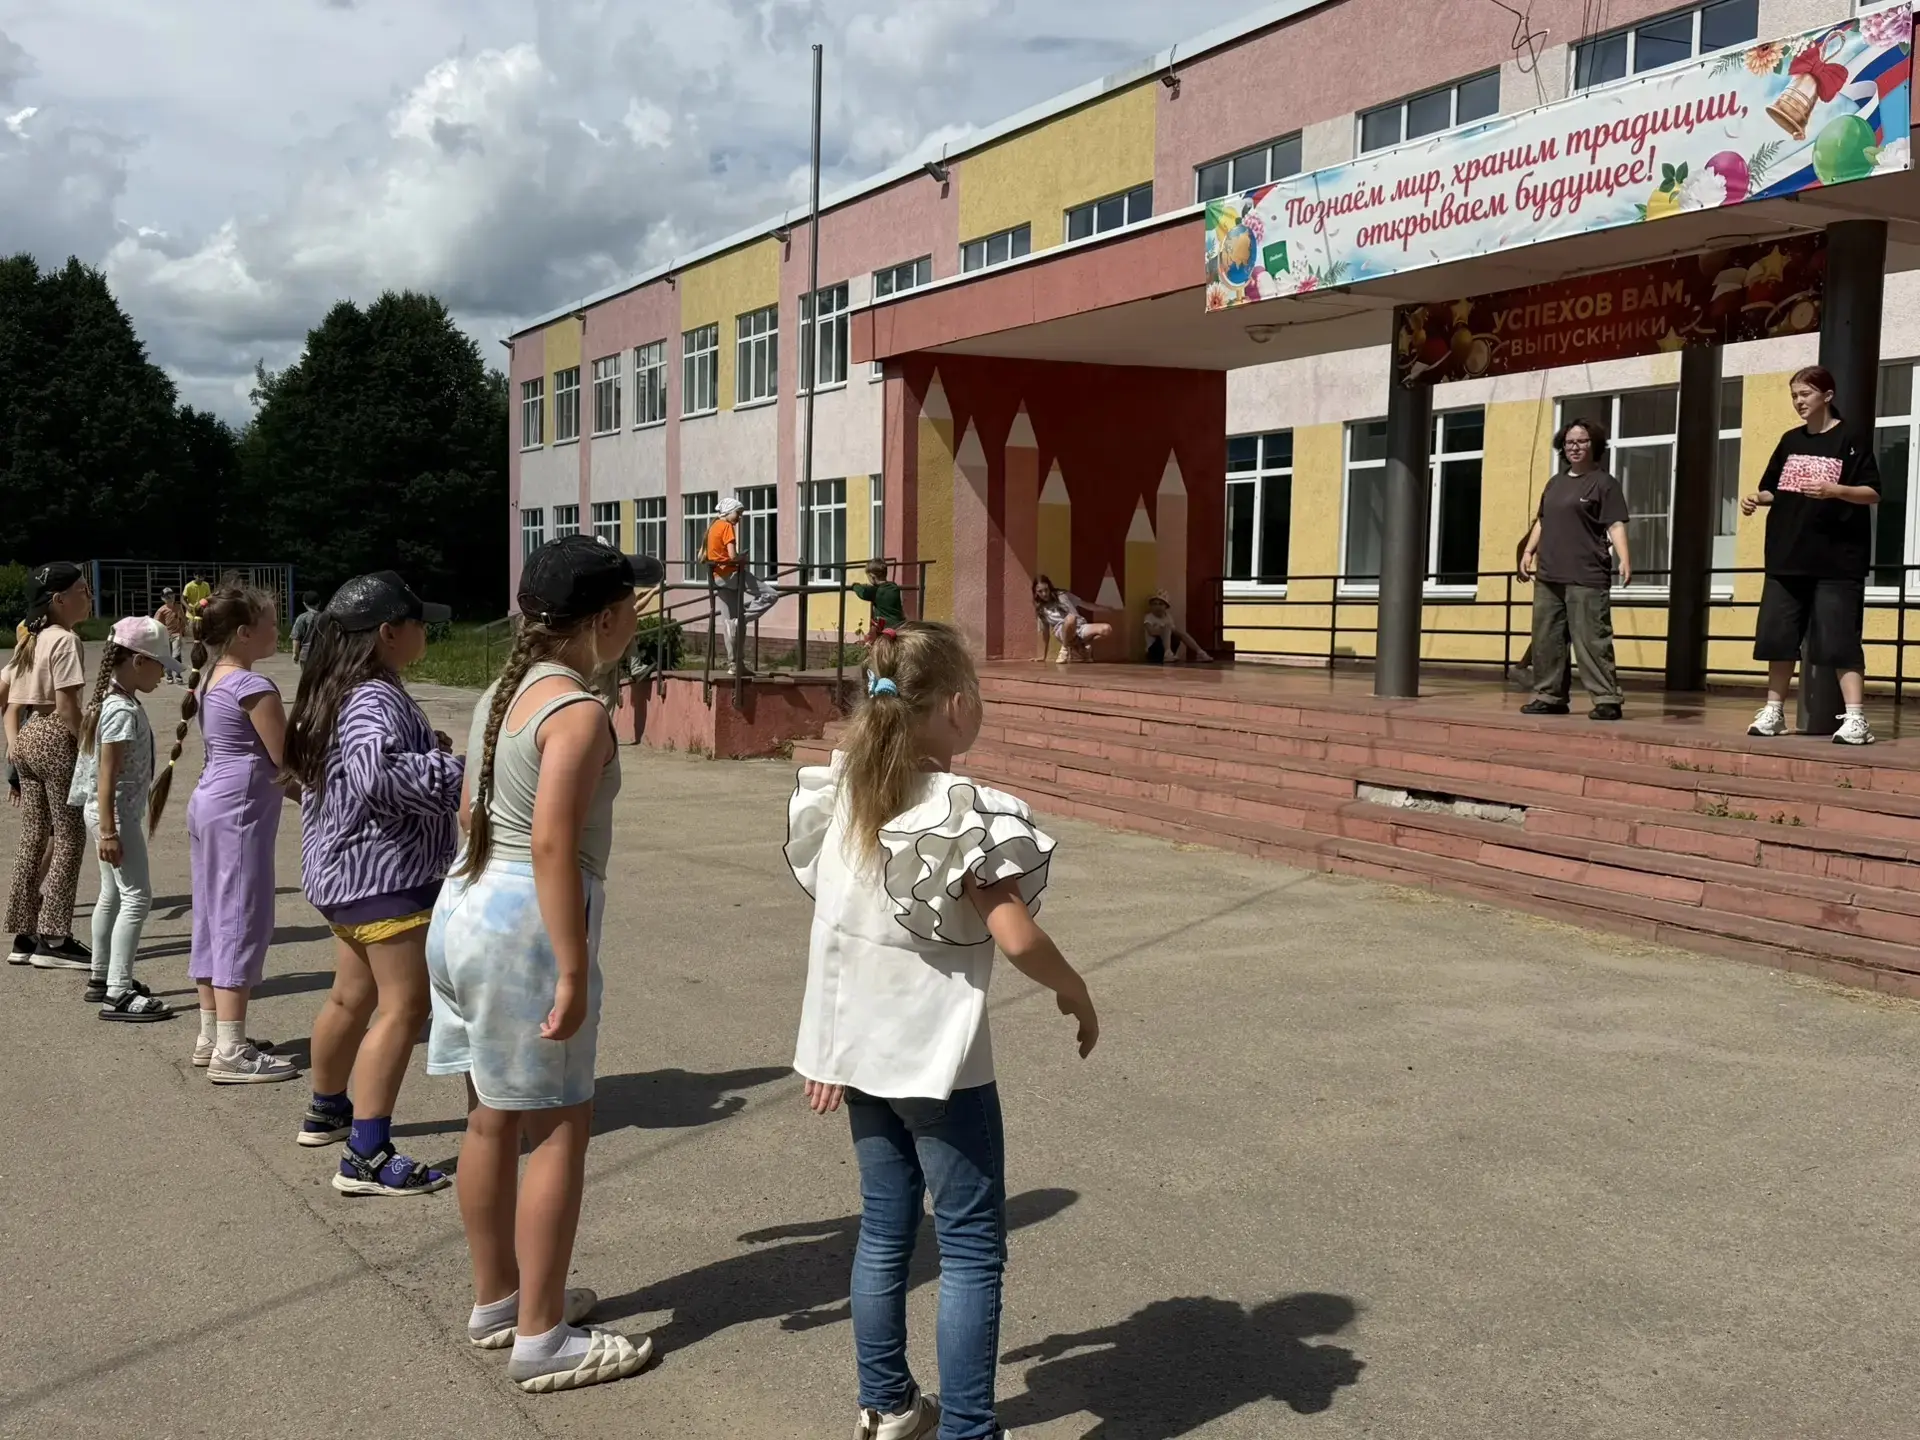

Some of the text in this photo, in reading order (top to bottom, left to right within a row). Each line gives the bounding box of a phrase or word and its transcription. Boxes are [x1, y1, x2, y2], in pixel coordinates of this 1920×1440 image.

[1285, 90, 1749, 234] Познаём мир, храним традиции,
[1356, 145, 1656, 252] открываем будущее!
[1492, 278, 1691, 333] УСПЕХОВ ВАМ,
[1511, 315, 1666, 356] ВЫПУСКНИКИ
